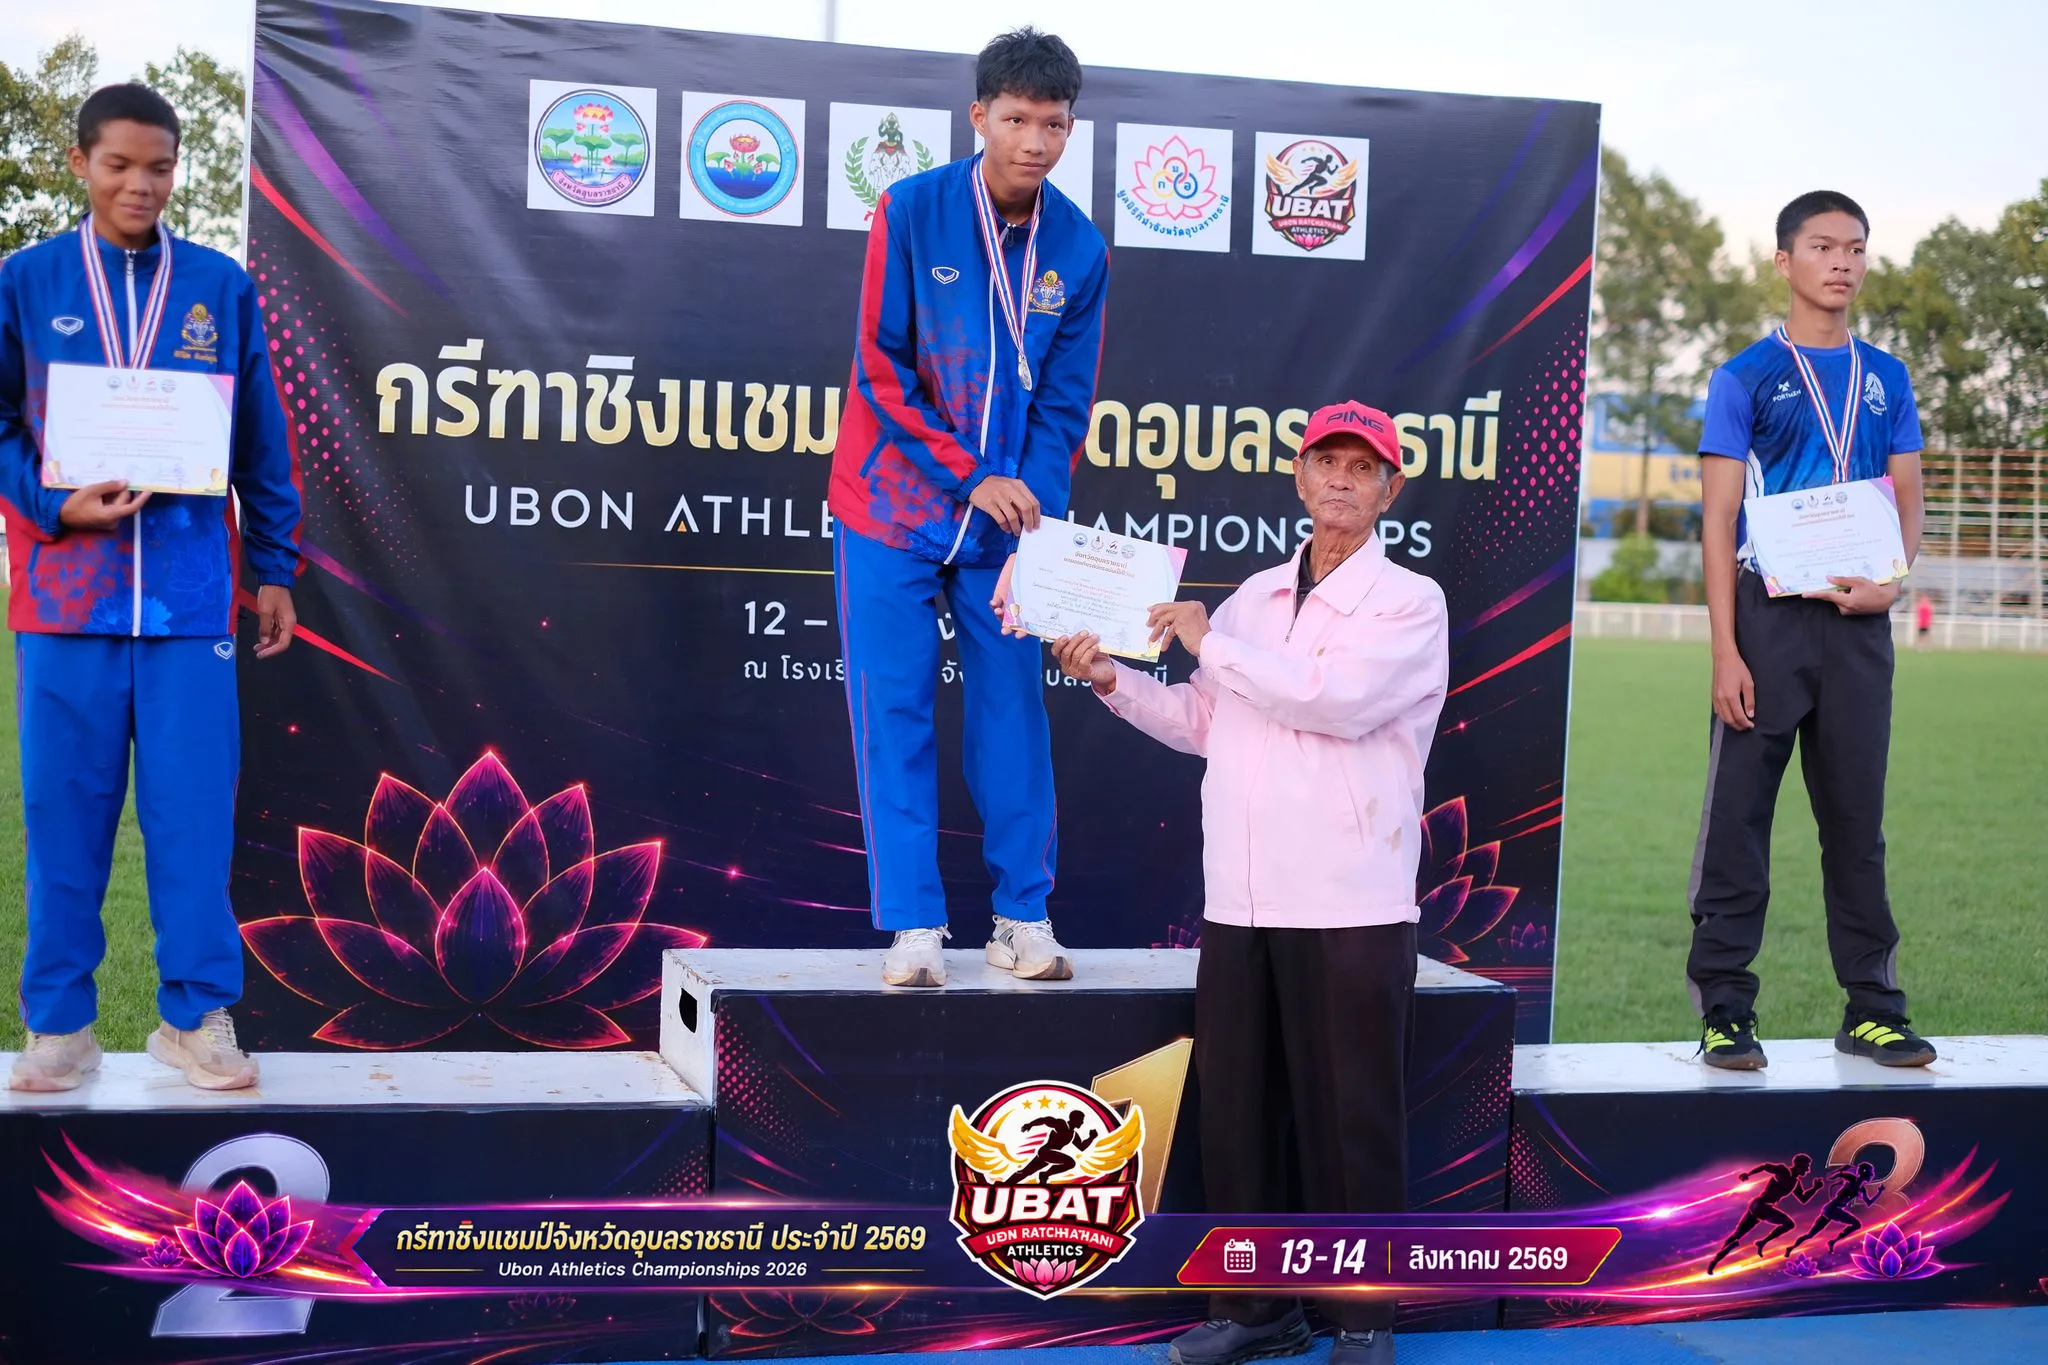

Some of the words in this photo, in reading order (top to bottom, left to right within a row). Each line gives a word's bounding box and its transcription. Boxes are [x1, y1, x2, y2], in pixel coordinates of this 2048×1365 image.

[1271, 195, 1350, 220] UBAT
[1291, 226, 1329, 235] ATHLETICS
[1326, 410, 1384, 433] PING
[464, 484, 633, 531] UBON
[664, 494, 834, 539] ATHLE
[744, 600, 786, 635] 12
[744, 660, 767, 679] ณ
